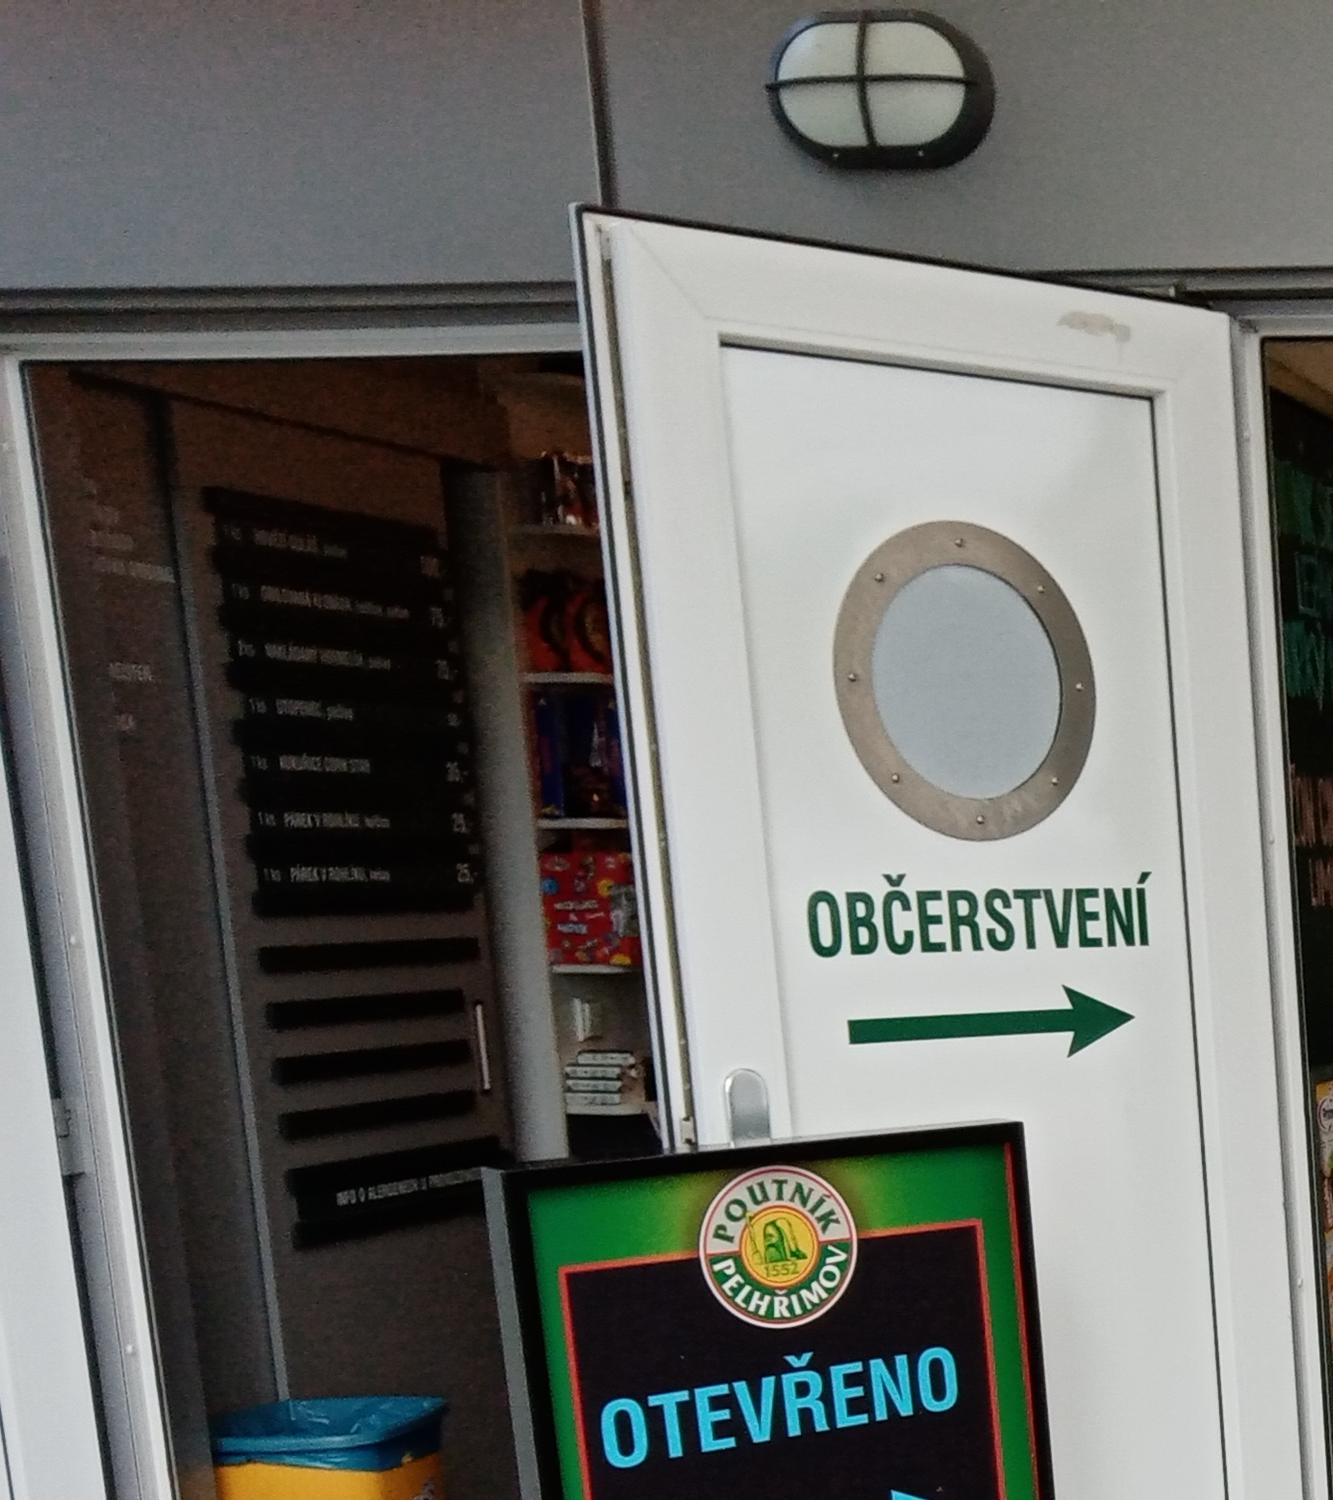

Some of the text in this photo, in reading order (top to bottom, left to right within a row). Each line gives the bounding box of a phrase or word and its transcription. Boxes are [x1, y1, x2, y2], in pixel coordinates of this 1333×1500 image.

[807, 871, 1152, 959] OBČERSTVENÍ
[711, 1178, 842, 1245] POUTNÍK
[711, 1244, 849, 1319] PELHŘIMOV
[763, 1262, 800, 1278] 1552
[600, 1346, 959, 1470] OTEVŘENO
